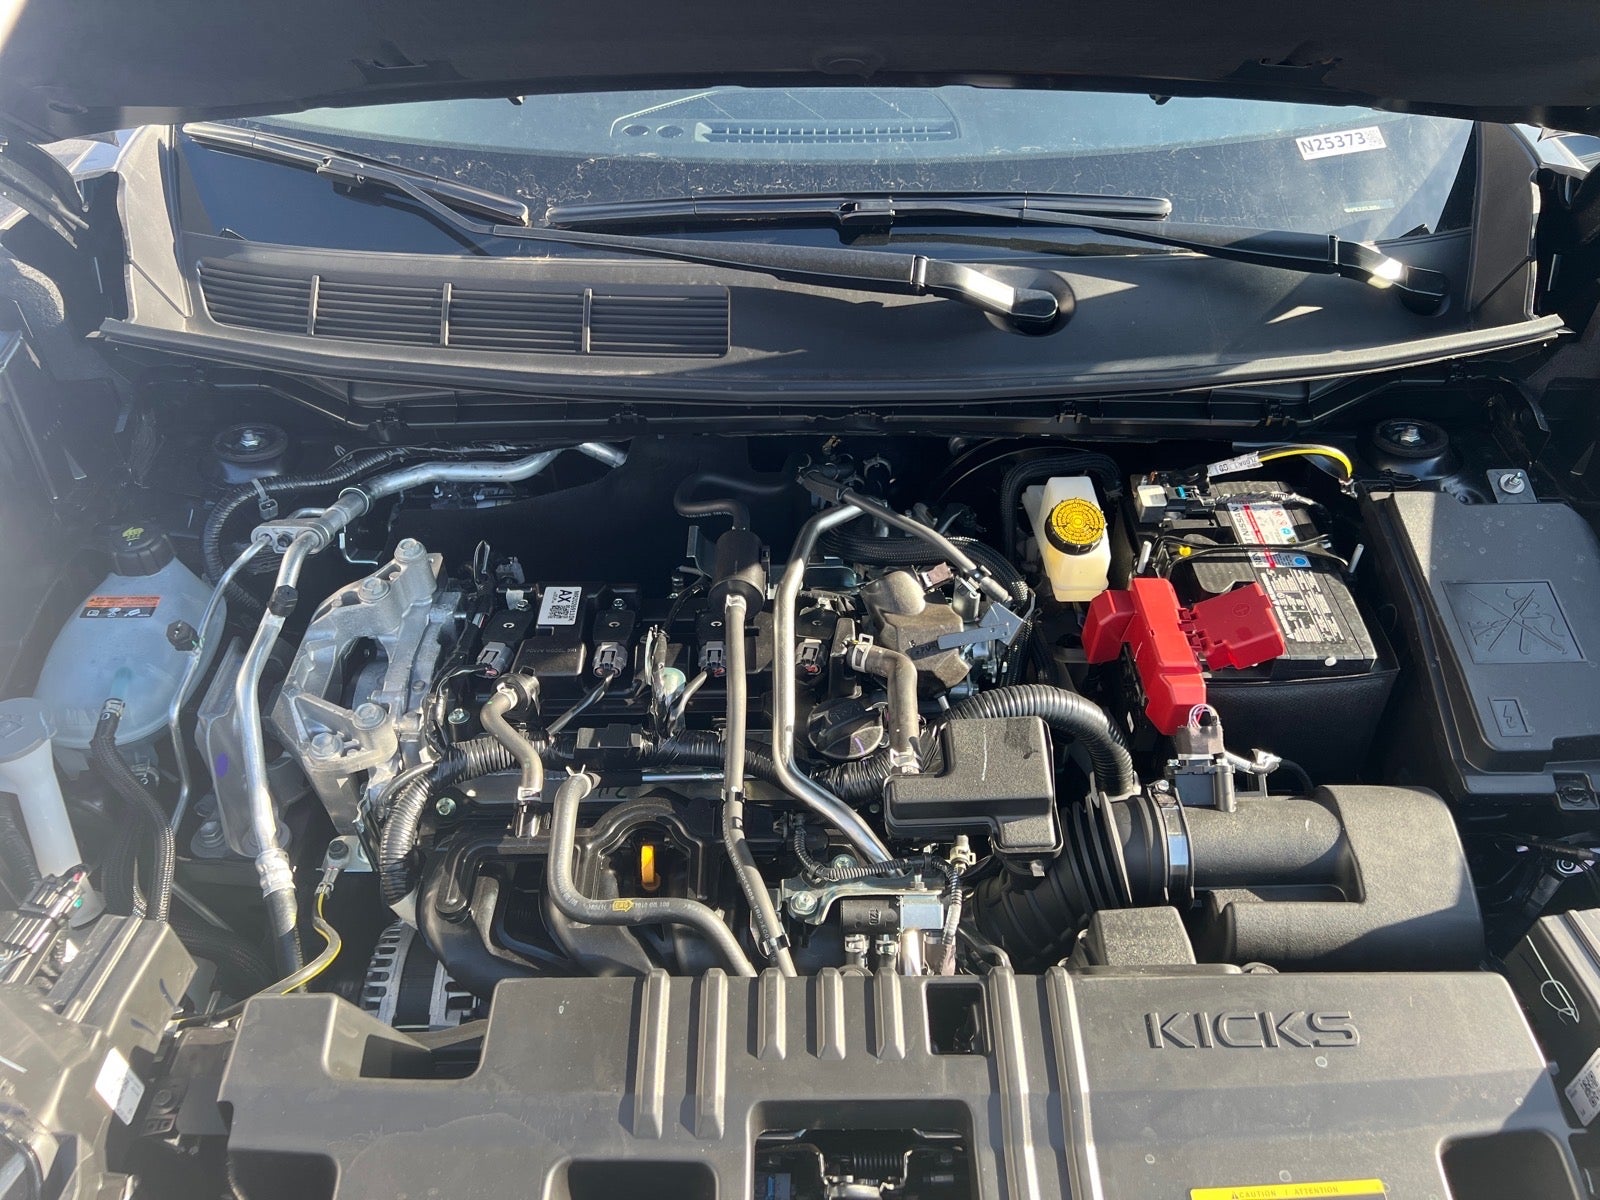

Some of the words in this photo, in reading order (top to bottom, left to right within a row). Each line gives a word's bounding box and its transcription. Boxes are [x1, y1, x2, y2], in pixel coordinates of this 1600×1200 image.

[1300, 132, 1366, 153] N25373
[1230, 505, 1250, 536] NISSAN
[557, 589, 573, 603] AX
[1144, 1011, 1361, 1049] KICKS
[1240, 1190, 1277, 1199] CAUTION
[1294, 1186, 1339, 1196] ATTENTION
